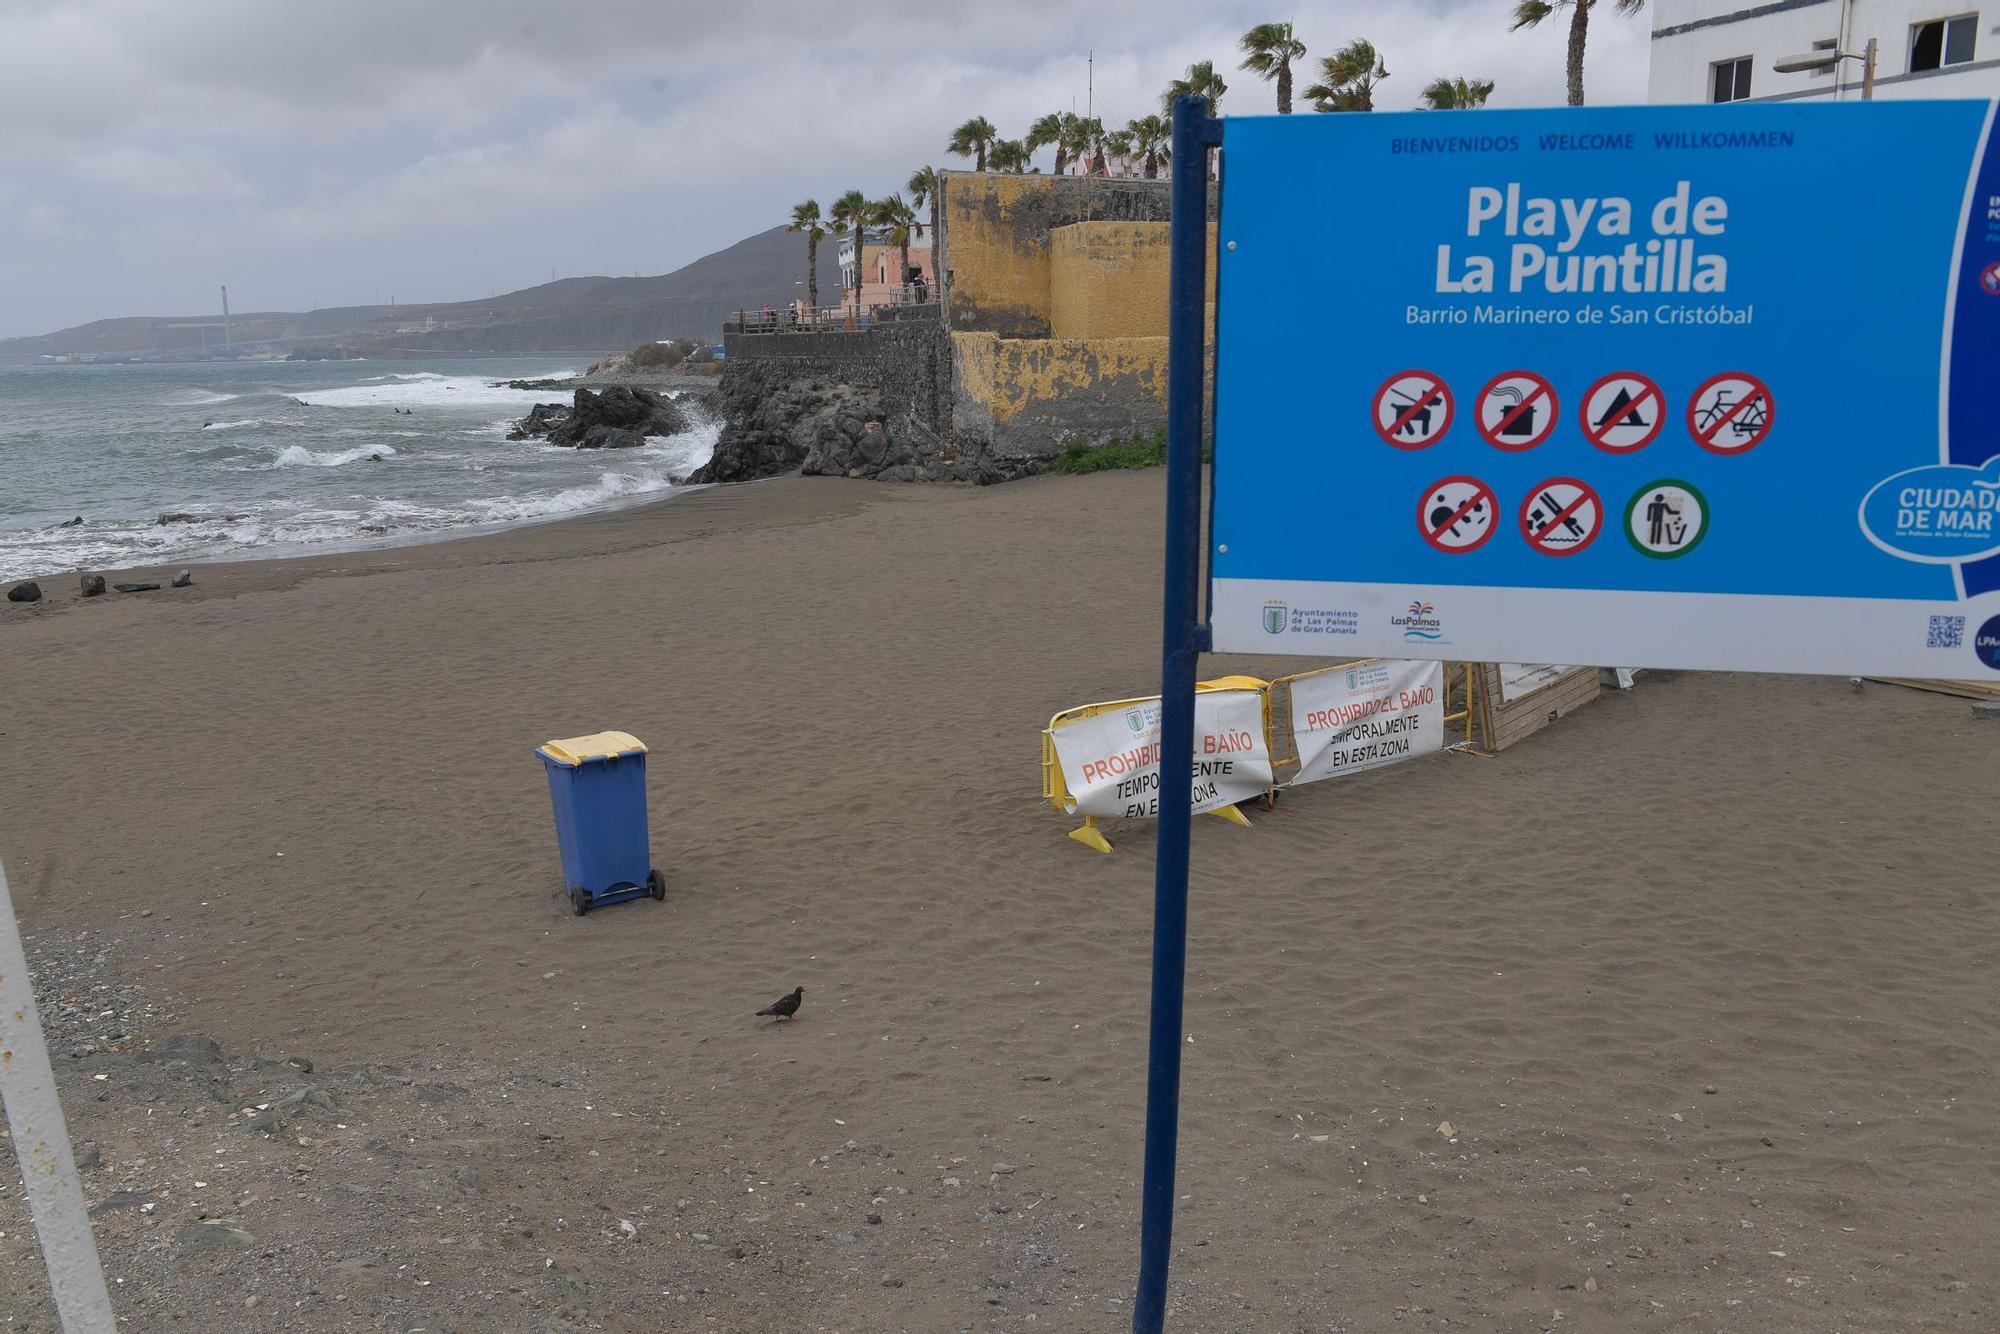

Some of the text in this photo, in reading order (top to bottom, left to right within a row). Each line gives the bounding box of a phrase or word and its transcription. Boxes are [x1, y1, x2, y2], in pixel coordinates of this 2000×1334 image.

[1391, 131, 1795, 154] BIENVENIDOS WELCOME WILLKOMMEN
[1466, 180, 1728, 253] Playa de
[1435, 238, 1728, 293] La Puntilla
[1406, 304, 1754, 325] Barrio Marinero de San Cristóbal
[1897, 509, 1993, 531] DE MAR
[1291, 608, 1358, 618] Ayuntamiento
[1291, 616, 1357, 626] de Las Palmas
[1291, 625, 1302, 633] de
[1326, 626, 1357, 634] Canaria
[1307, 698, 1381, 732] PROHIBIDO
[1380, 694, 1398, 713] EL
[1400, 684, 1434, 711] BAÑO
[1330, 714, 1419, 745] EMPORALMENTE
[1082, 728, 1253, 784] PROHIBID BAÑO
[1333, 750, 1349, 767] EN
[1351, 745, 1378, 763] ESTA
[1380, 738, 1410, 757] ZONA
[1125, 801, 1147, 818] EN
[1191, 782, 1218, 804] ONA
